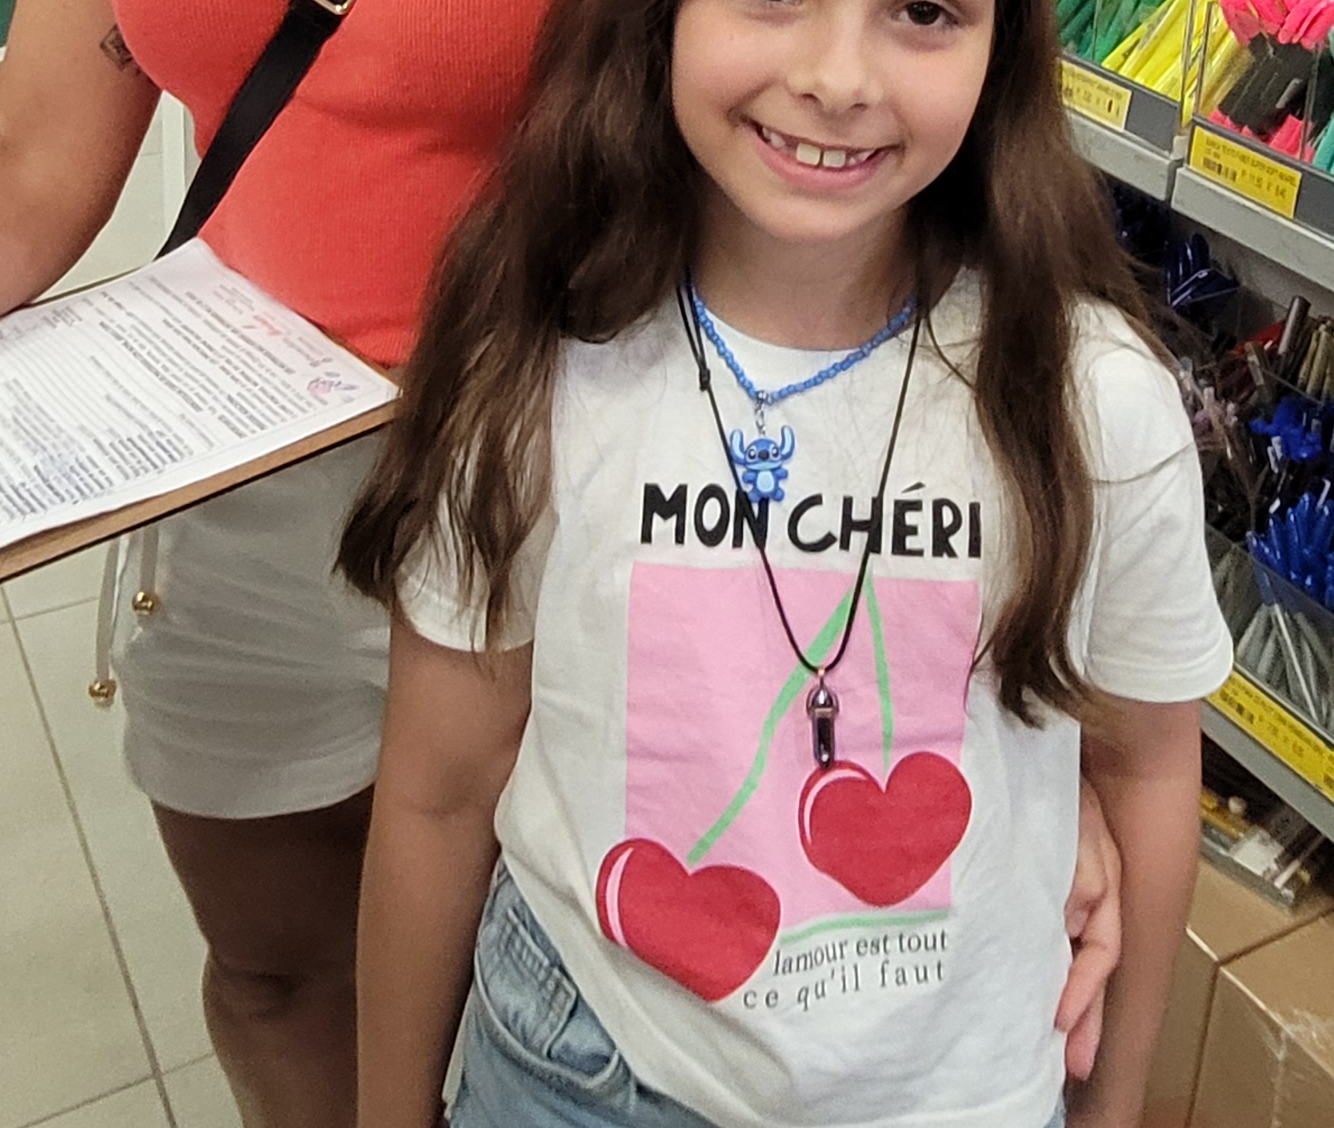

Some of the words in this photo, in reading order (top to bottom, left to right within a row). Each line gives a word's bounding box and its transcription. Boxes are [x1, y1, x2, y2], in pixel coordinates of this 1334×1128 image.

[640, 483, 769, 549] MON
[787, 482, 981, 559] CHÉRI
[856, 934, 890, 957] est
[899, 929, 946, 953] tout
[743, 990, 779, 1009] ce
[796, 963, 860, 1012] qu'il
[880, 959, 943, 988] faut
